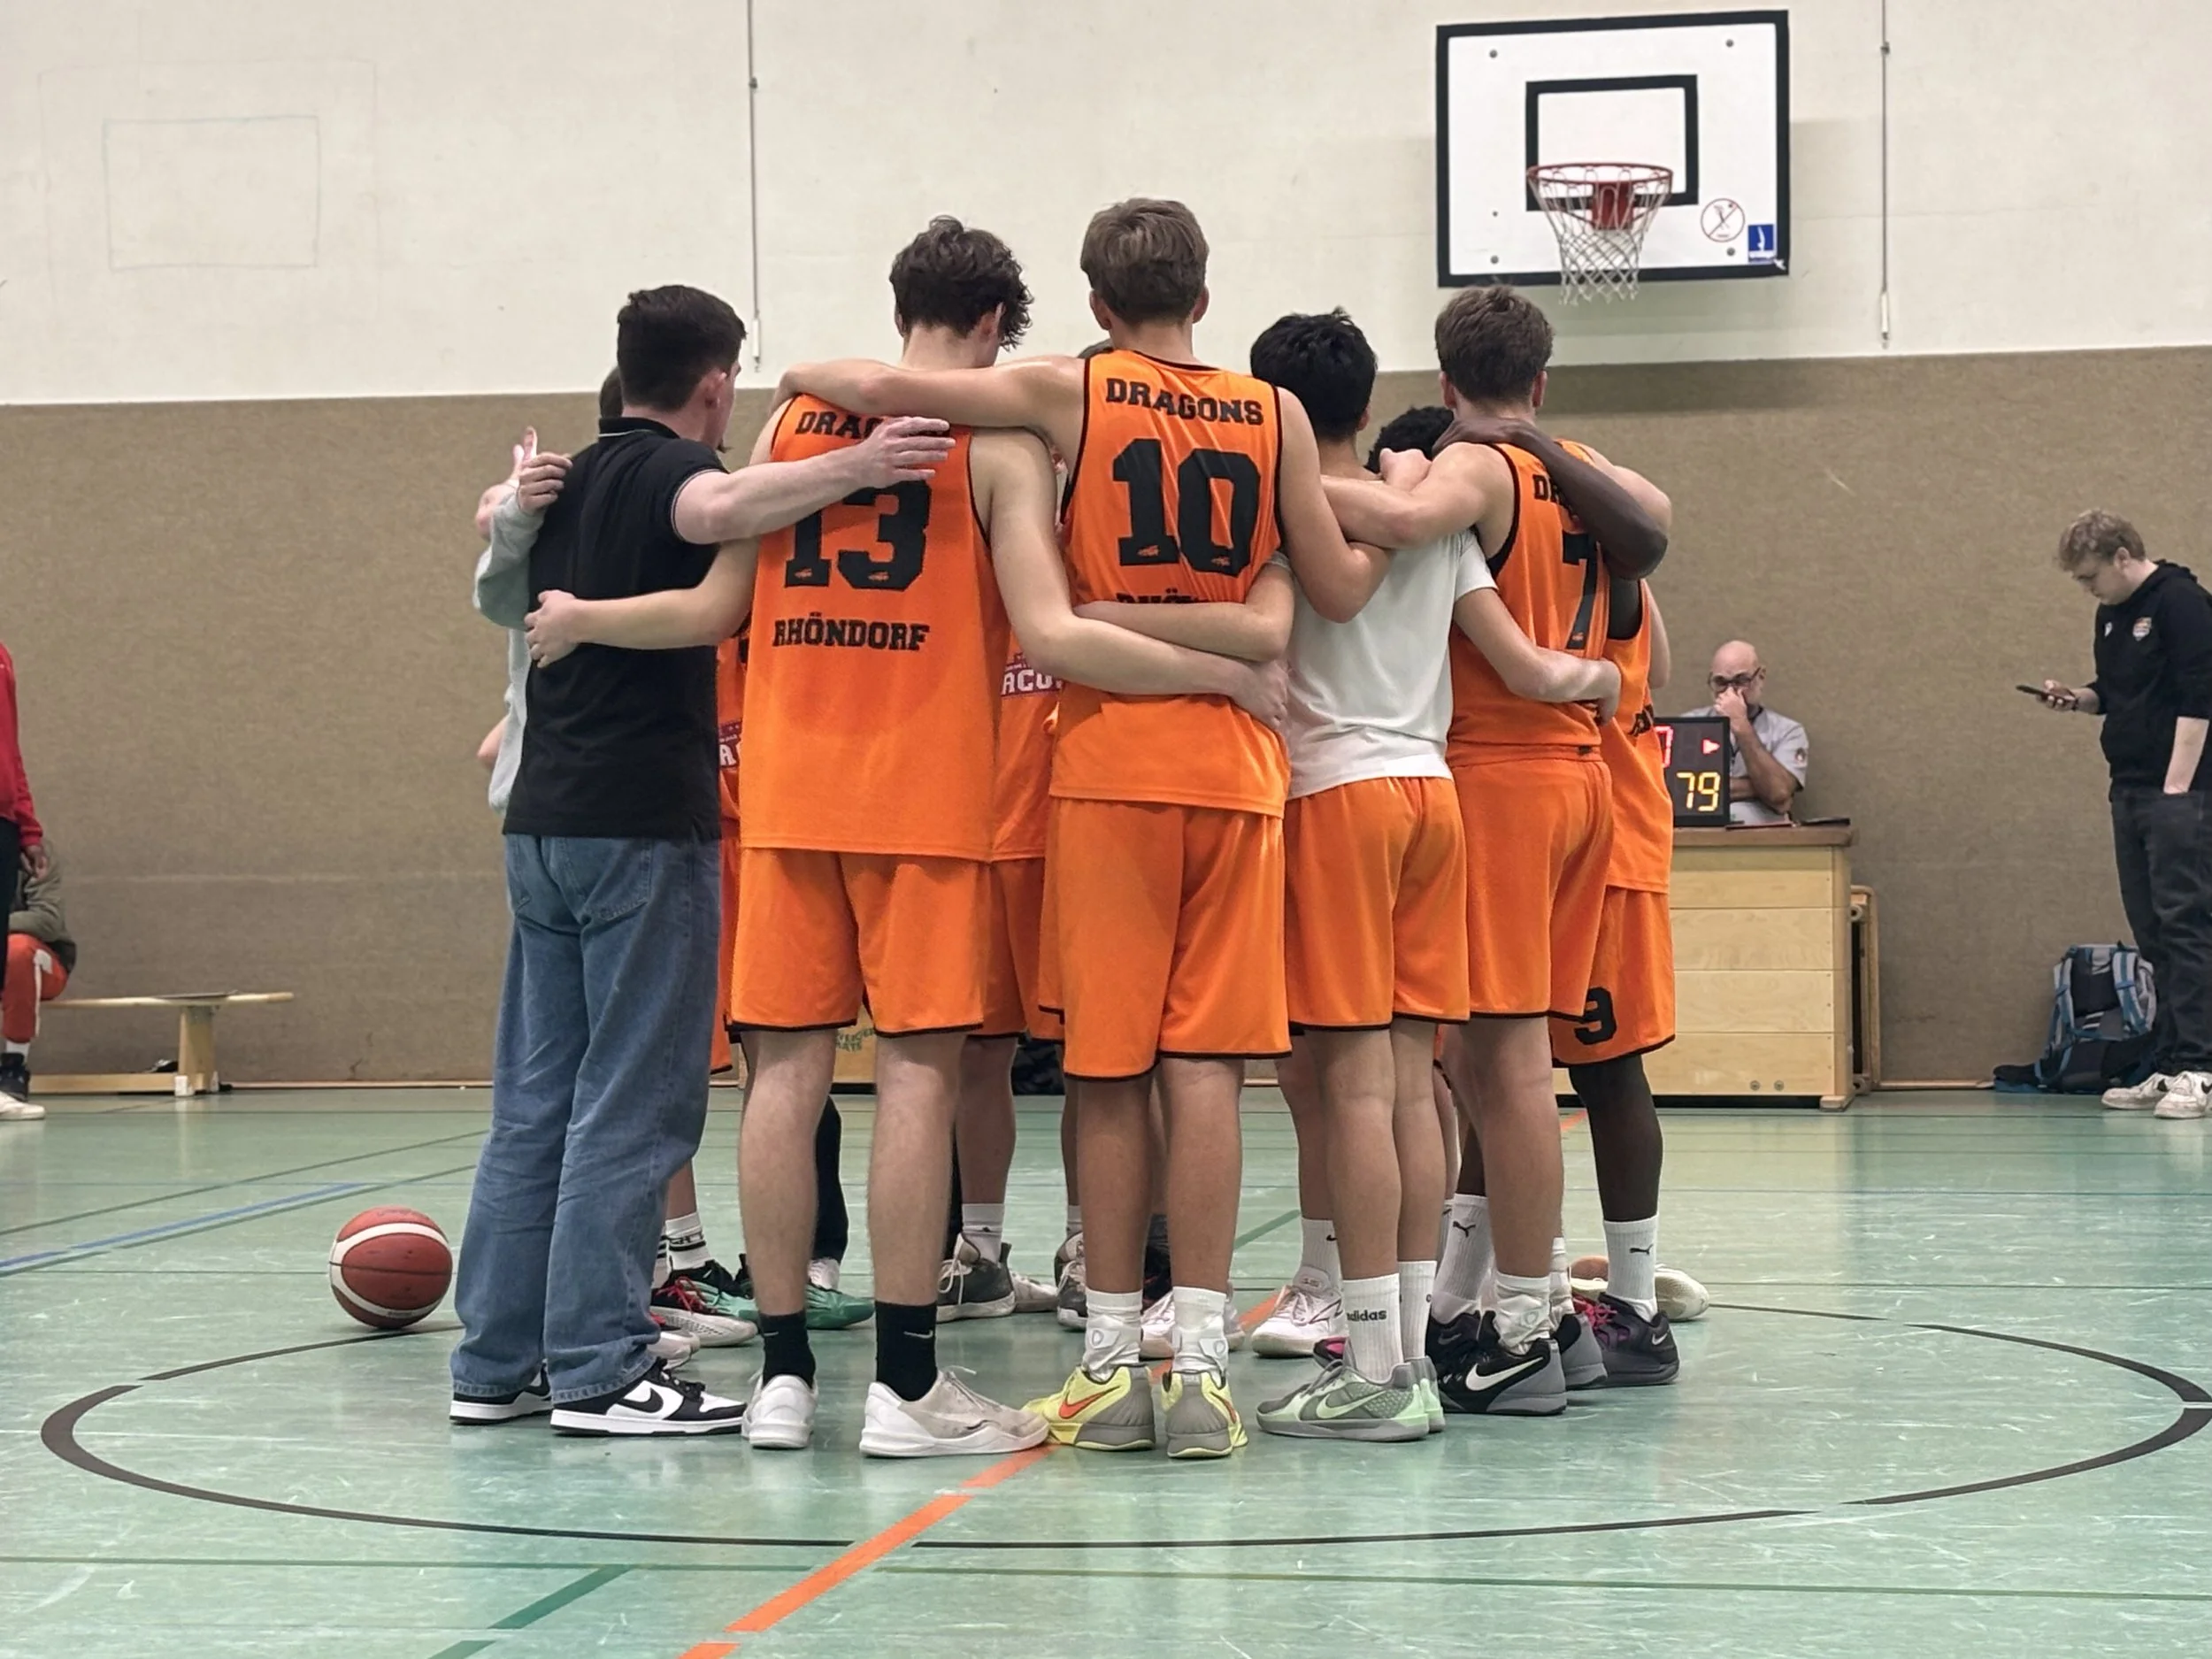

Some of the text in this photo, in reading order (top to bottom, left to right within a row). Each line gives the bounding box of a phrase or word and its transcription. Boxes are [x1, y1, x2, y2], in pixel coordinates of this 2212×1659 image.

[1106, 378, 1264, 426] DRAGONS
[784, 479, 933, 592] 13
[1112, 438, 1261, 578] 10
[772, 611, 930, 651] RHÖNDORF
[1563, 532, 1599, 650] 7
[1676, 772, 1721, 812] 79
